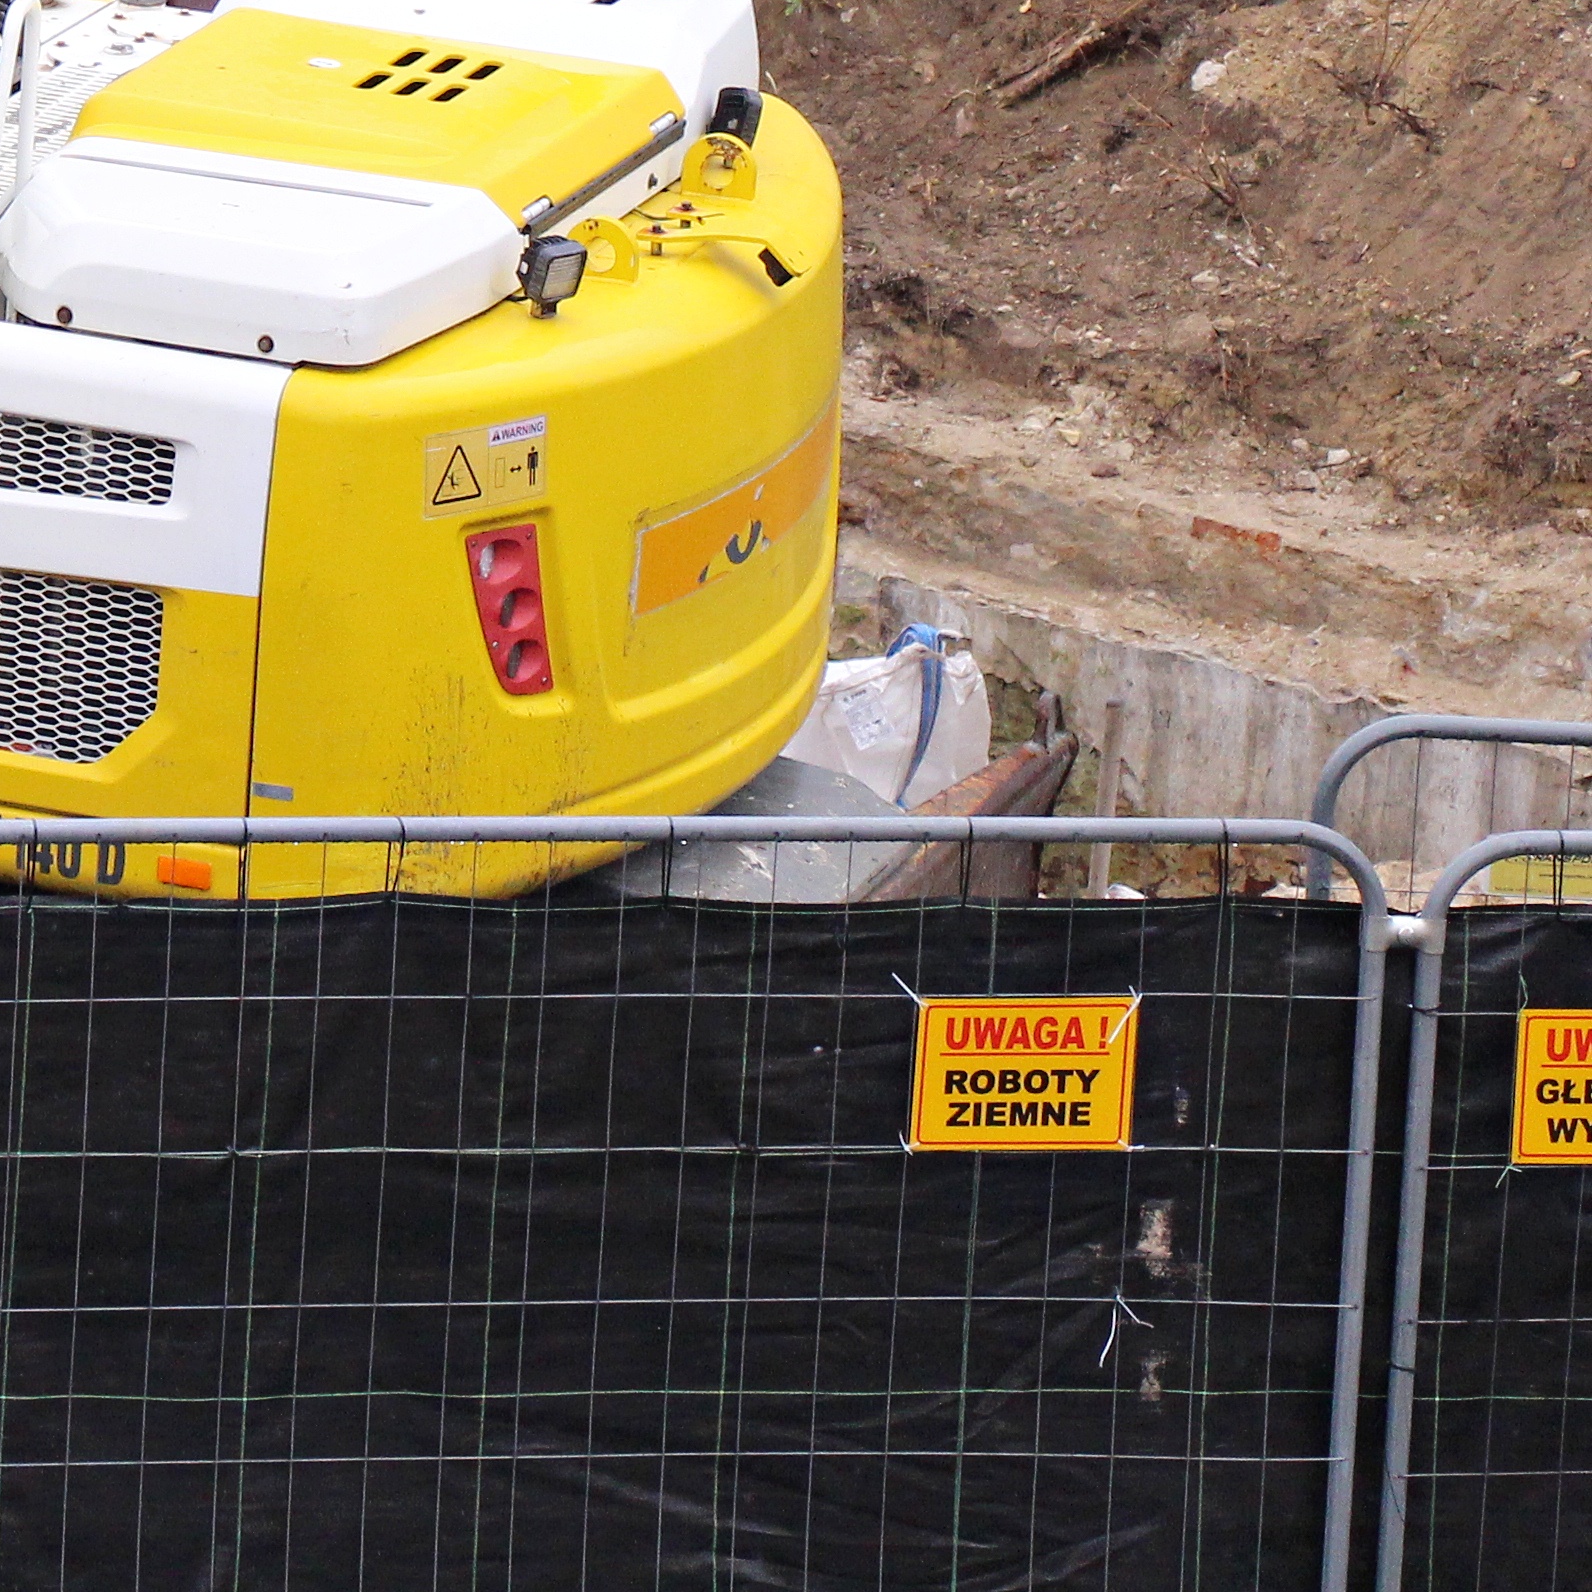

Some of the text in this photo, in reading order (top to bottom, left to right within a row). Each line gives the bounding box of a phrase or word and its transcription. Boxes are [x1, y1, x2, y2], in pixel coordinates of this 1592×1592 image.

[501, 420, 544, 439] WARNING
[945, 1016, 1086, 1050] UWAGA
[943, 1068, 1100, 1095] ROBOTY
[945, 1101, 1092, 1127] ZIEMNE
